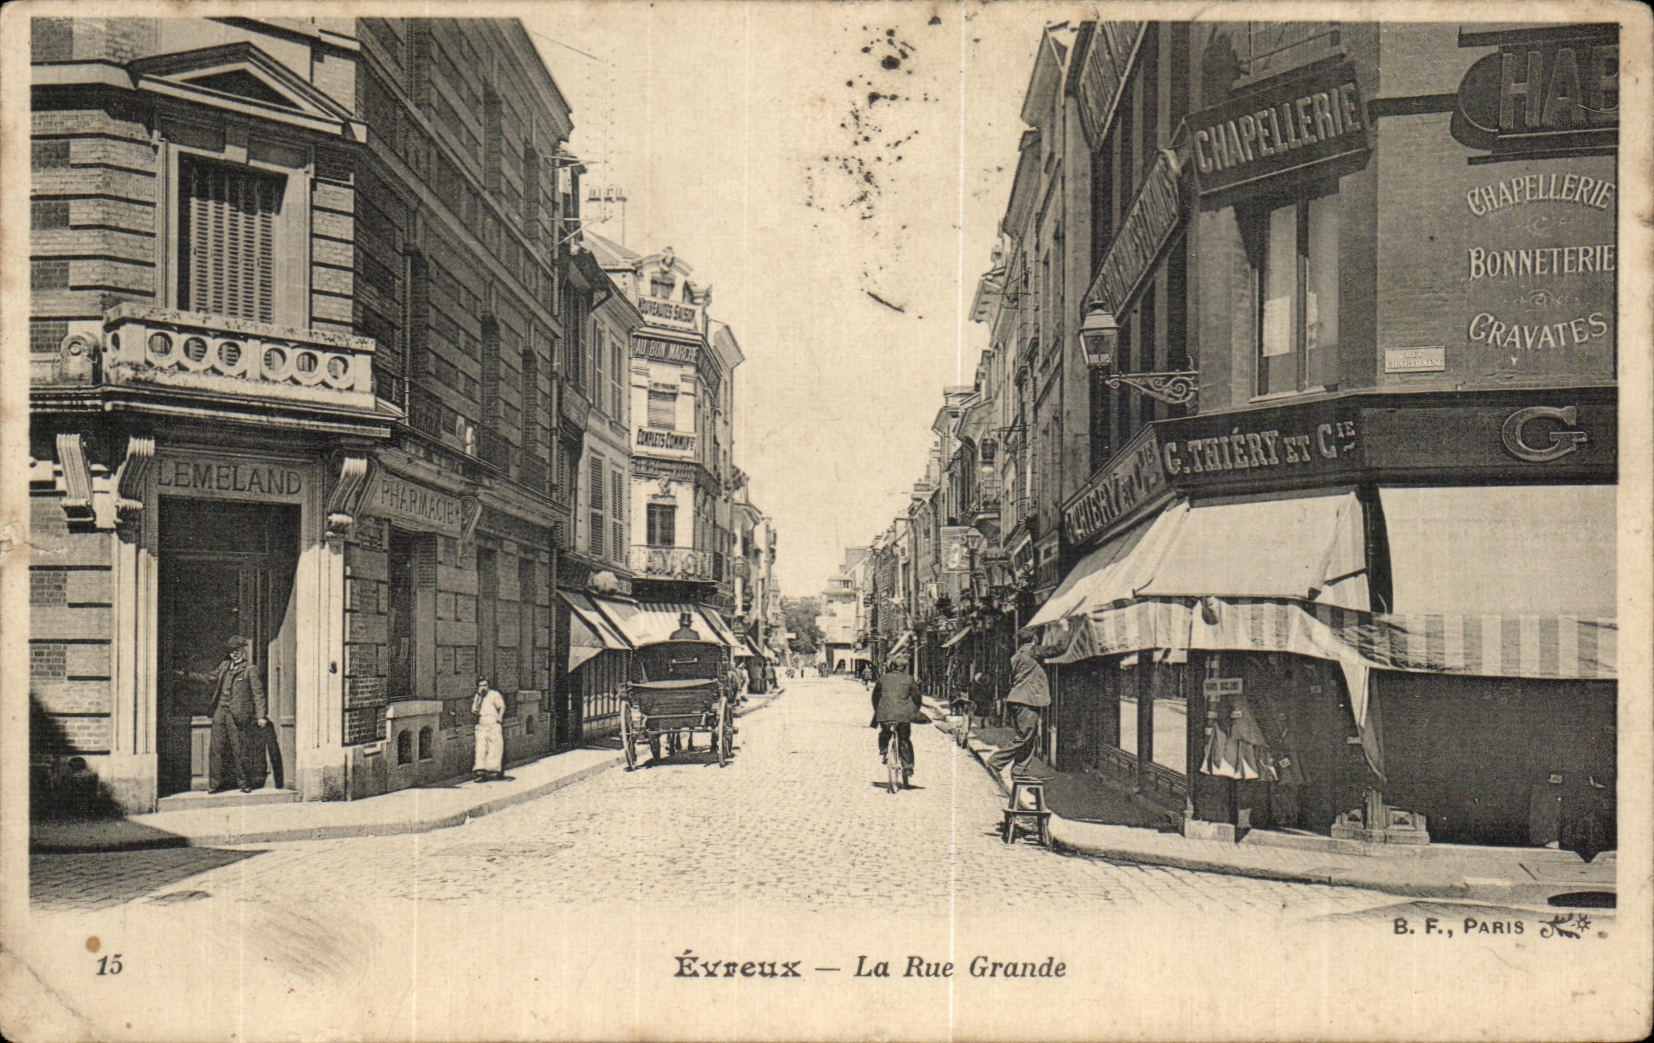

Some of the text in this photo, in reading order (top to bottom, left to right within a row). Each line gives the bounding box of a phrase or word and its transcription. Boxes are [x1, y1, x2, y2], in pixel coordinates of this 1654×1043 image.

[1194, 83, 1361, 174] CHAPELLERIE
[1467, 173, 1616, 217] CHAPELLERIE
[1468, 245, 1616, 282] BONNETERIE
[158, 458, 301, 495] LEMELAND
[381, 479, 454, 524] PHARMACIE
